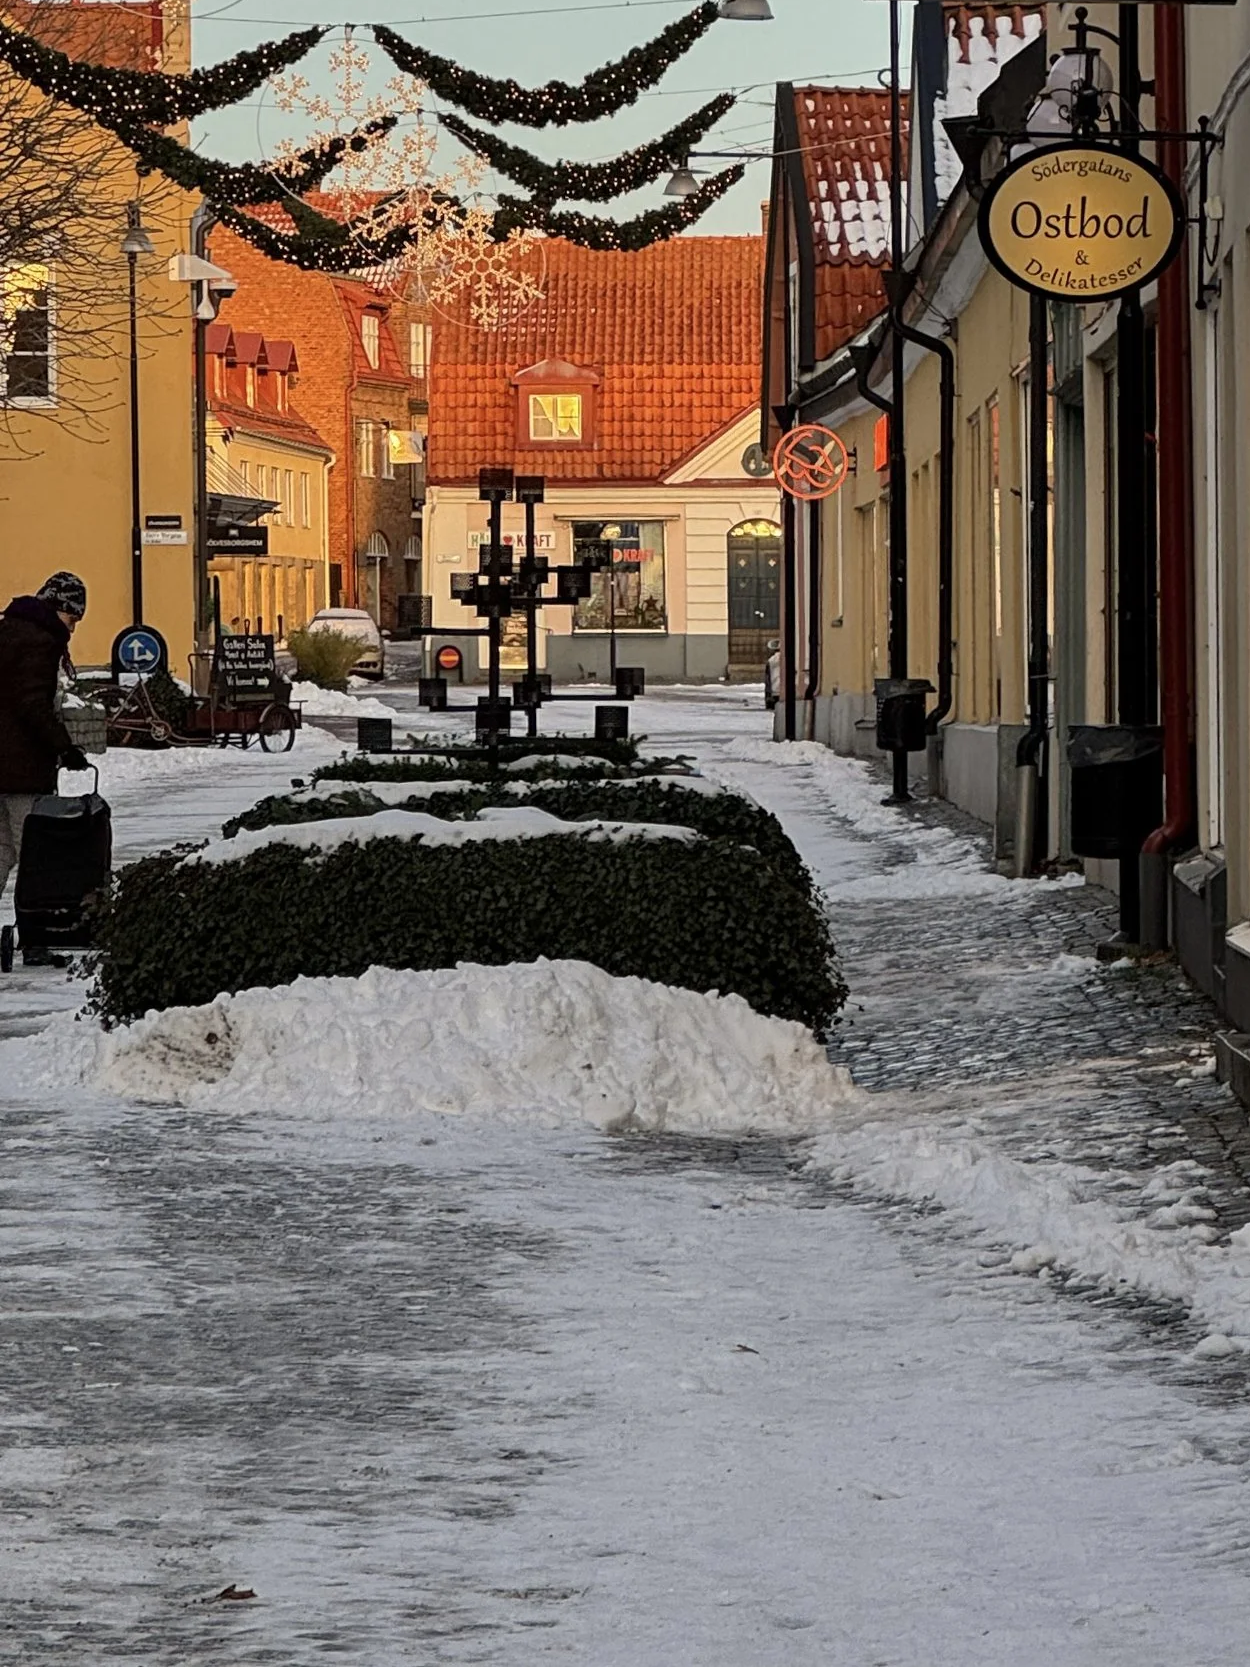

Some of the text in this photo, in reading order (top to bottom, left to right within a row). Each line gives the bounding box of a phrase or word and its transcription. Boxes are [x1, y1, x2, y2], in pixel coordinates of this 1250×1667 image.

[1031, 156, 1133, 183] Södergatans
[1011, 195, 1152, 239] Ostbod
[1075, 249, 1090, 266] &
[1024, 256, 1144, 290] Delikatesser
[517, 534, 551, 547] KAFT
[623, 548, 656, 562] KRAFT
